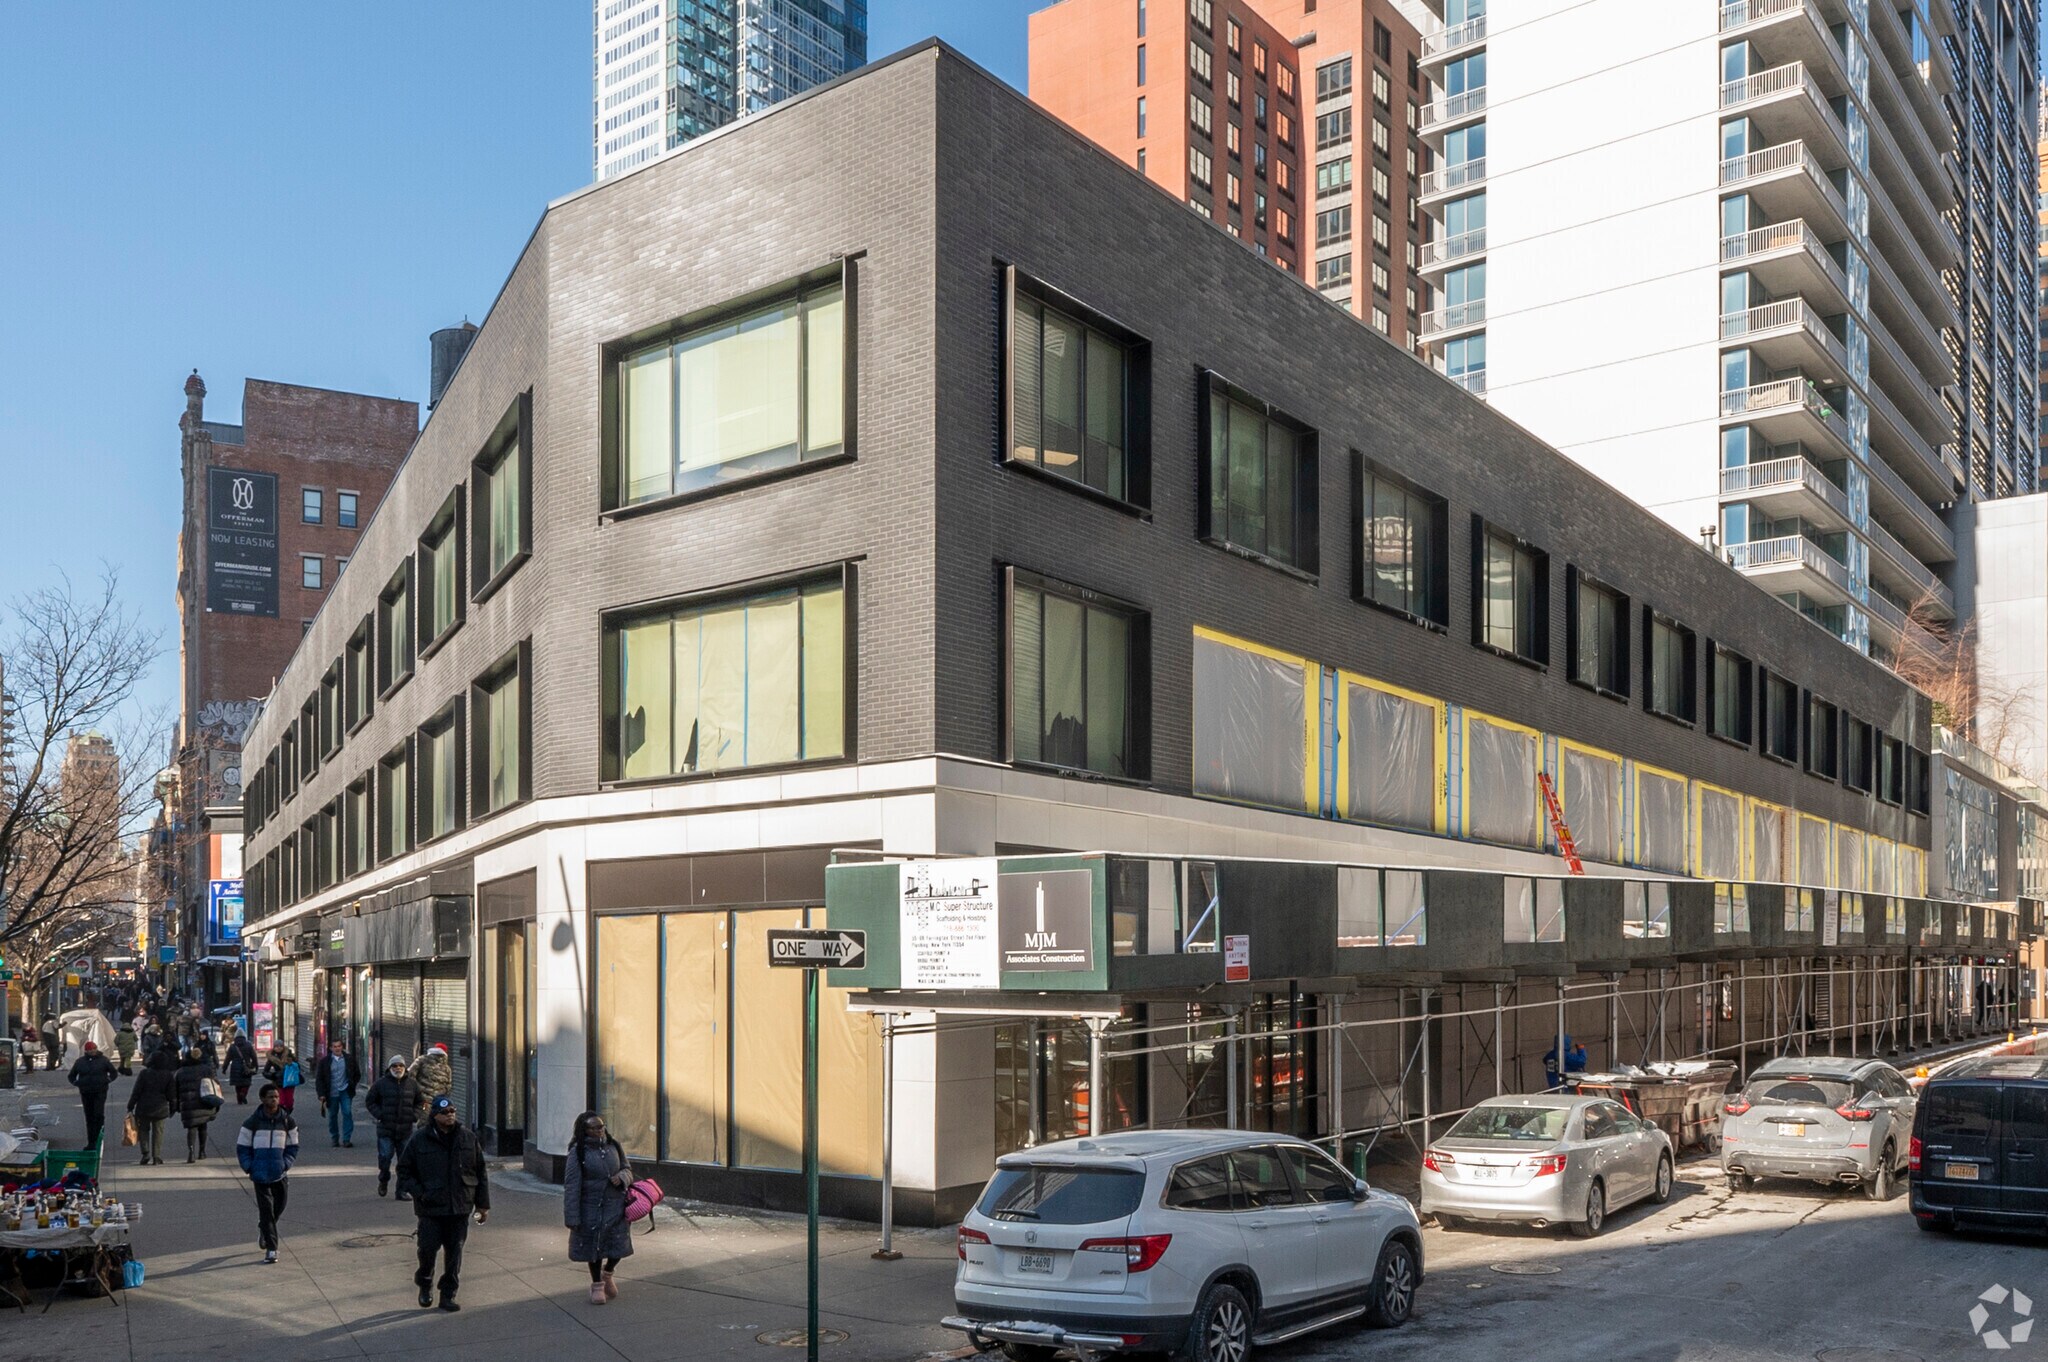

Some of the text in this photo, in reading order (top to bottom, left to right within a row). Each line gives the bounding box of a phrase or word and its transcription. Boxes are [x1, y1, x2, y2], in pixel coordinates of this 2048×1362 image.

[220, 513, 265, 523] OFFERMAN
[211, 533, 275, 549] NOW LEASING
[943, 901, 961, 911] Super
[963, 900, 993, 911] Structure
[1024, 932, 1057, 951] MJM
[777, 940, 852, 957] ONE WAY
[1006, 953, 1085, 963] Associates Construction
